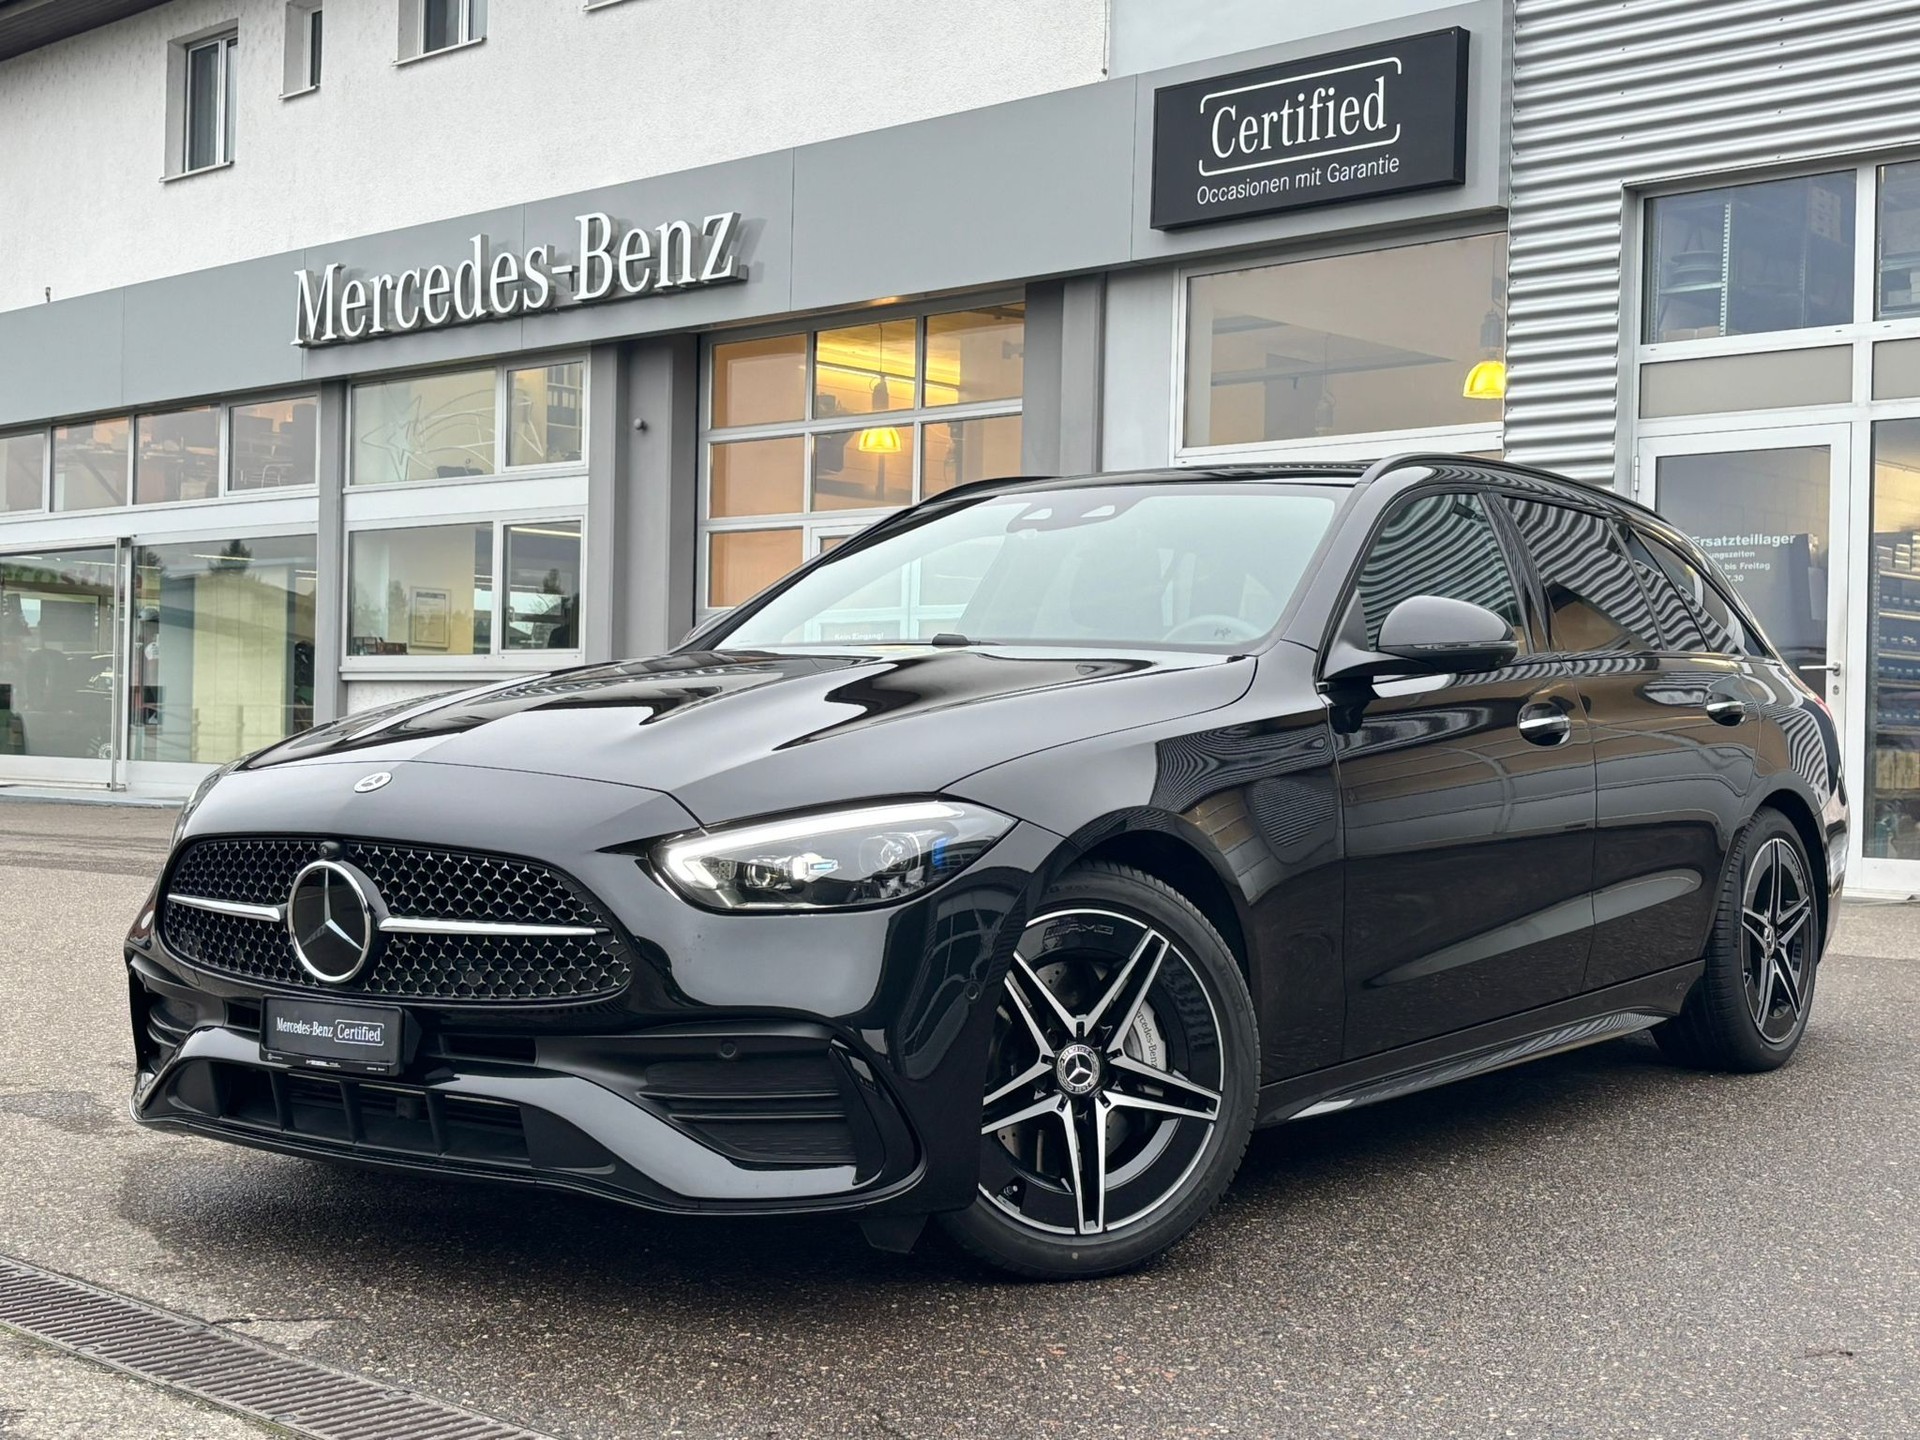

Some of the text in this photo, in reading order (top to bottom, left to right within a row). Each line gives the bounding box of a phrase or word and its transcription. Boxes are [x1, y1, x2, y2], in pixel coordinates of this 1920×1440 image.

[1211, 75, 1387, 158] Certified
[1196, 153, 1400, 205] Occasionen mit Garantie
[290, 211, 743, 347] Mercedes-Benz
[1740, 561, 1770, 571] Freitag
[276, 1017, 381, 1042] Mercedes-Benz Certified
